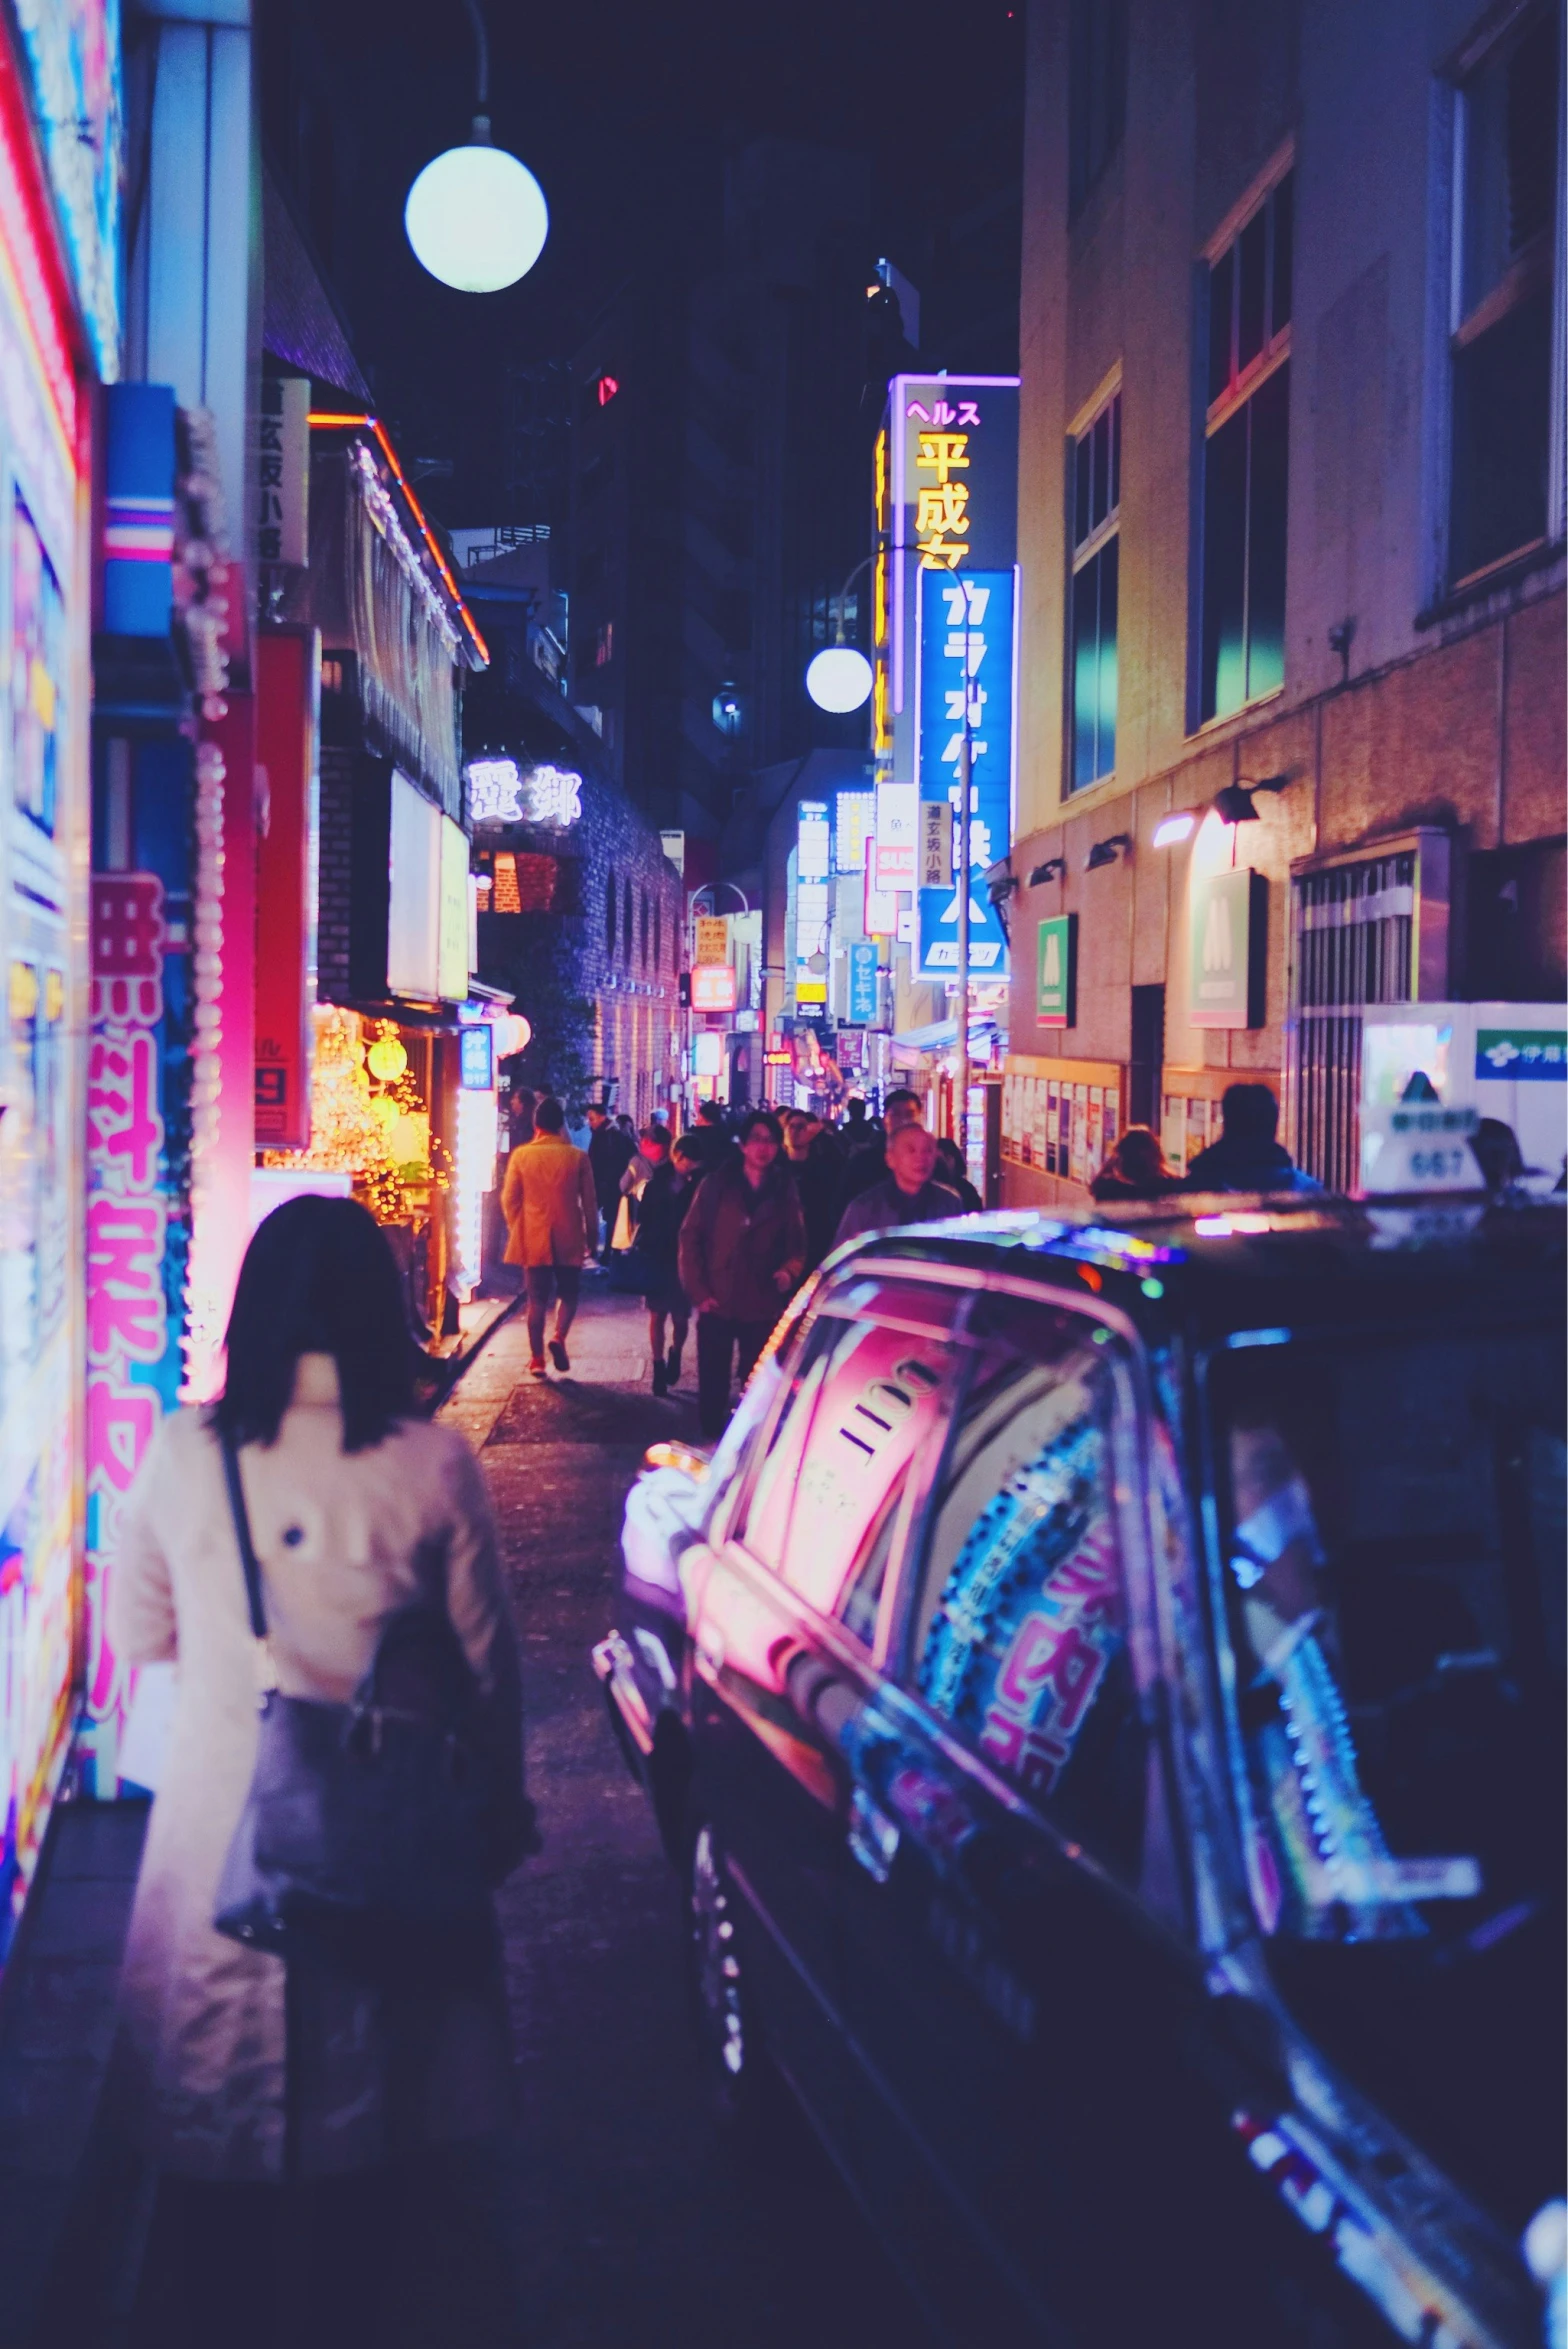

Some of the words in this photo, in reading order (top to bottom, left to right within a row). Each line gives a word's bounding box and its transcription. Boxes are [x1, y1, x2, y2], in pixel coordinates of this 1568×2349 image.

[906, 400, 981, 426] ヘルス
[926, 805, 942, 885] 道玄坂小路
